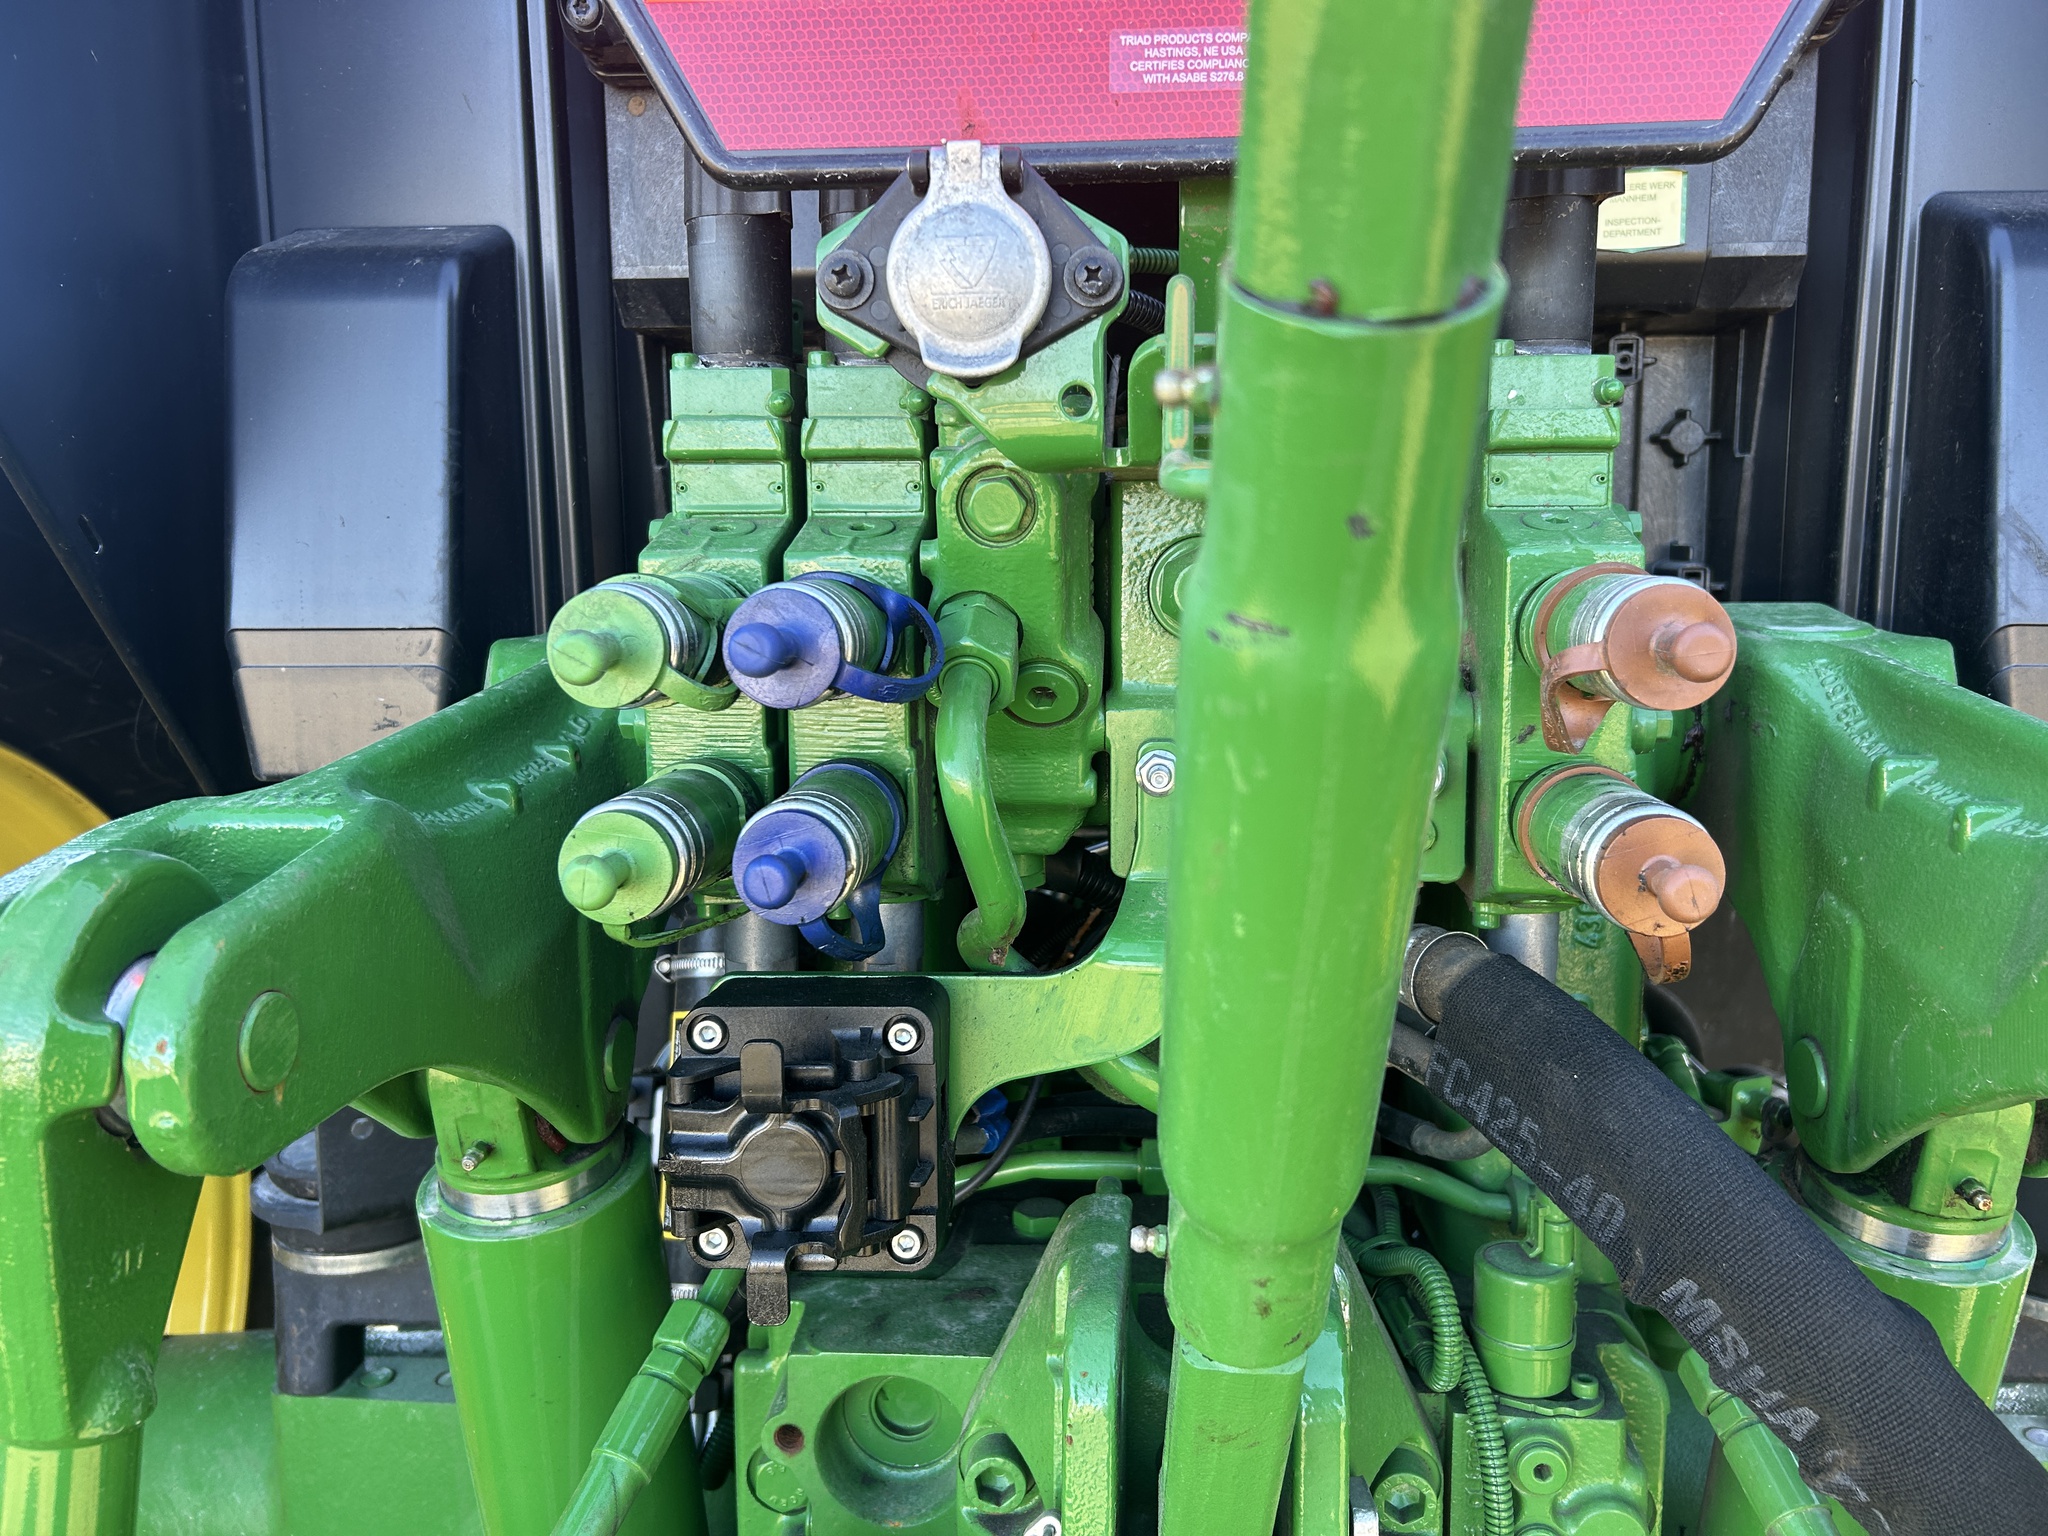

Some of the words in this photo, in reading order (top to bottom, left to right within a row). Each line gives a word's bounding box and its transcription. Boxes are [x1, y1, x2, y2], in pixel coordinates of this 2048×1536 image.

[1120, 35, 1151, 46] TRIAD
[1154, 33, 1213, 45] PRODUCTS
[1144, 47, 1201, 58] HASTINGS,
[1203, 46, 1219, 56] NE
[1221, 45, 1244, 56] USA
[1130, 60, 1185, 71] CERTIFIES
[1143, 73, 1170, 84] WITH
[1172, 72, 1207, 83] ASABE
[1210, 71, 1244, 82] S276.8
[1649, 181, 1676, 190] WERK
[1603, 228, 1662, 239] DEPARTMENT
[932, 297, 963, 310] ERICH
[965, 296, 1006, 309] JAEGER
